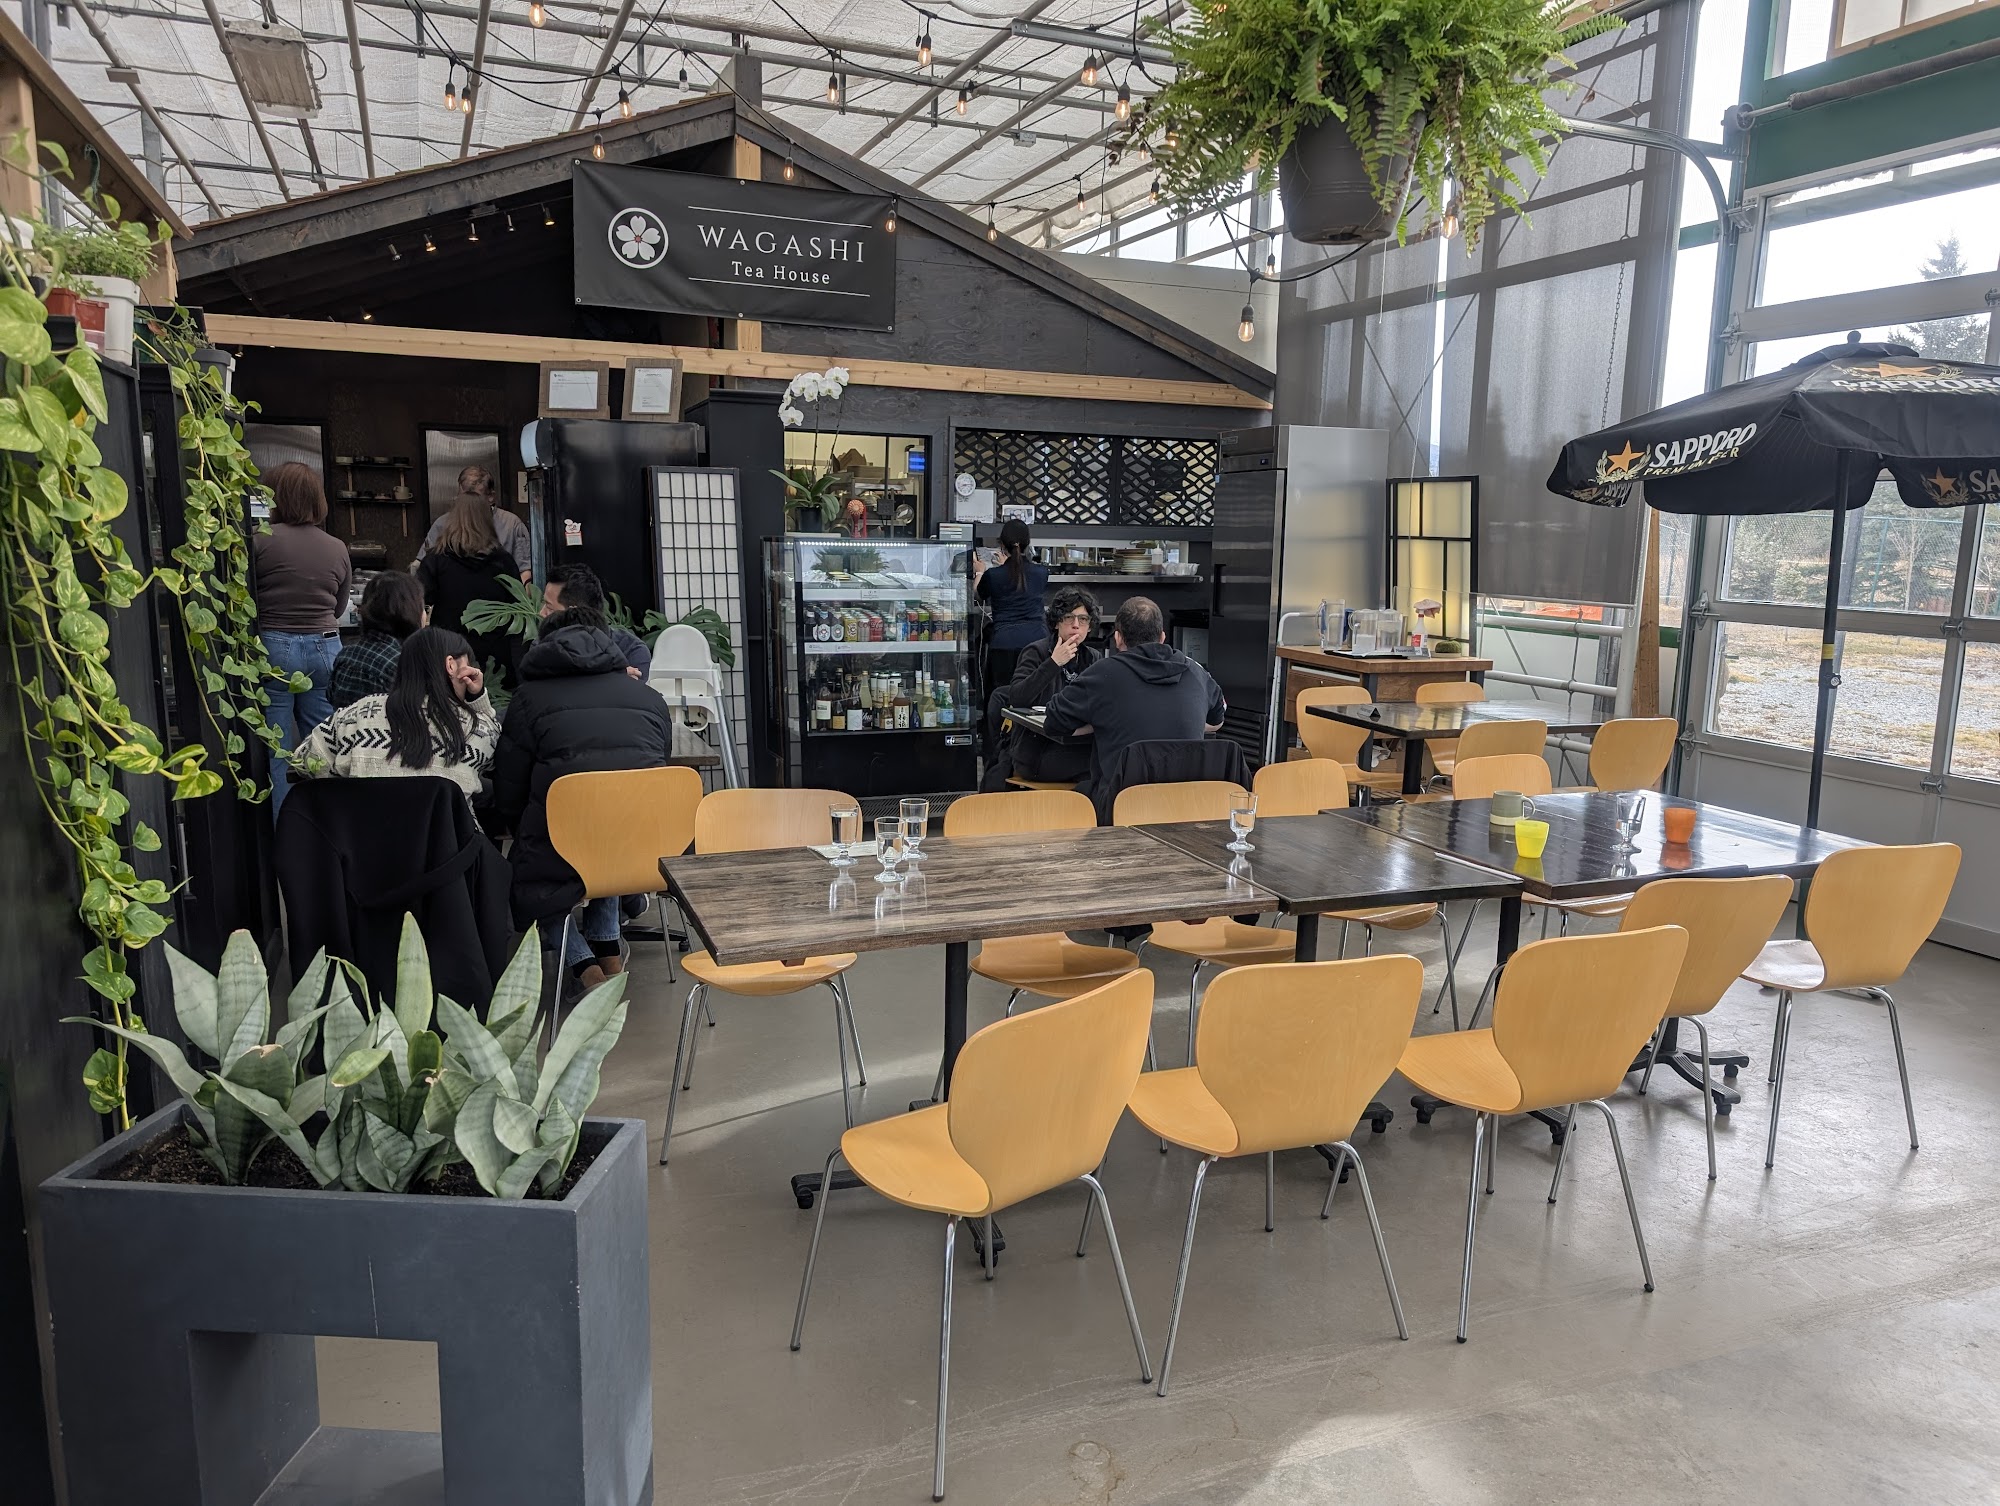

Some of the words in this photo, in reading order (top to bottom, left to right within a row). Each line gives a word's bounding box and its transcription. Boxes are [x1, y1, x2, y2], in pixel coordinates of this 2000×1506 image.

[697, 225, 864, 262] WAGASHI
[732, 261, 764, 278] Tea
[773, 266, 831, 285] House
[1649, 423, 1757, 467] SAPPORO
